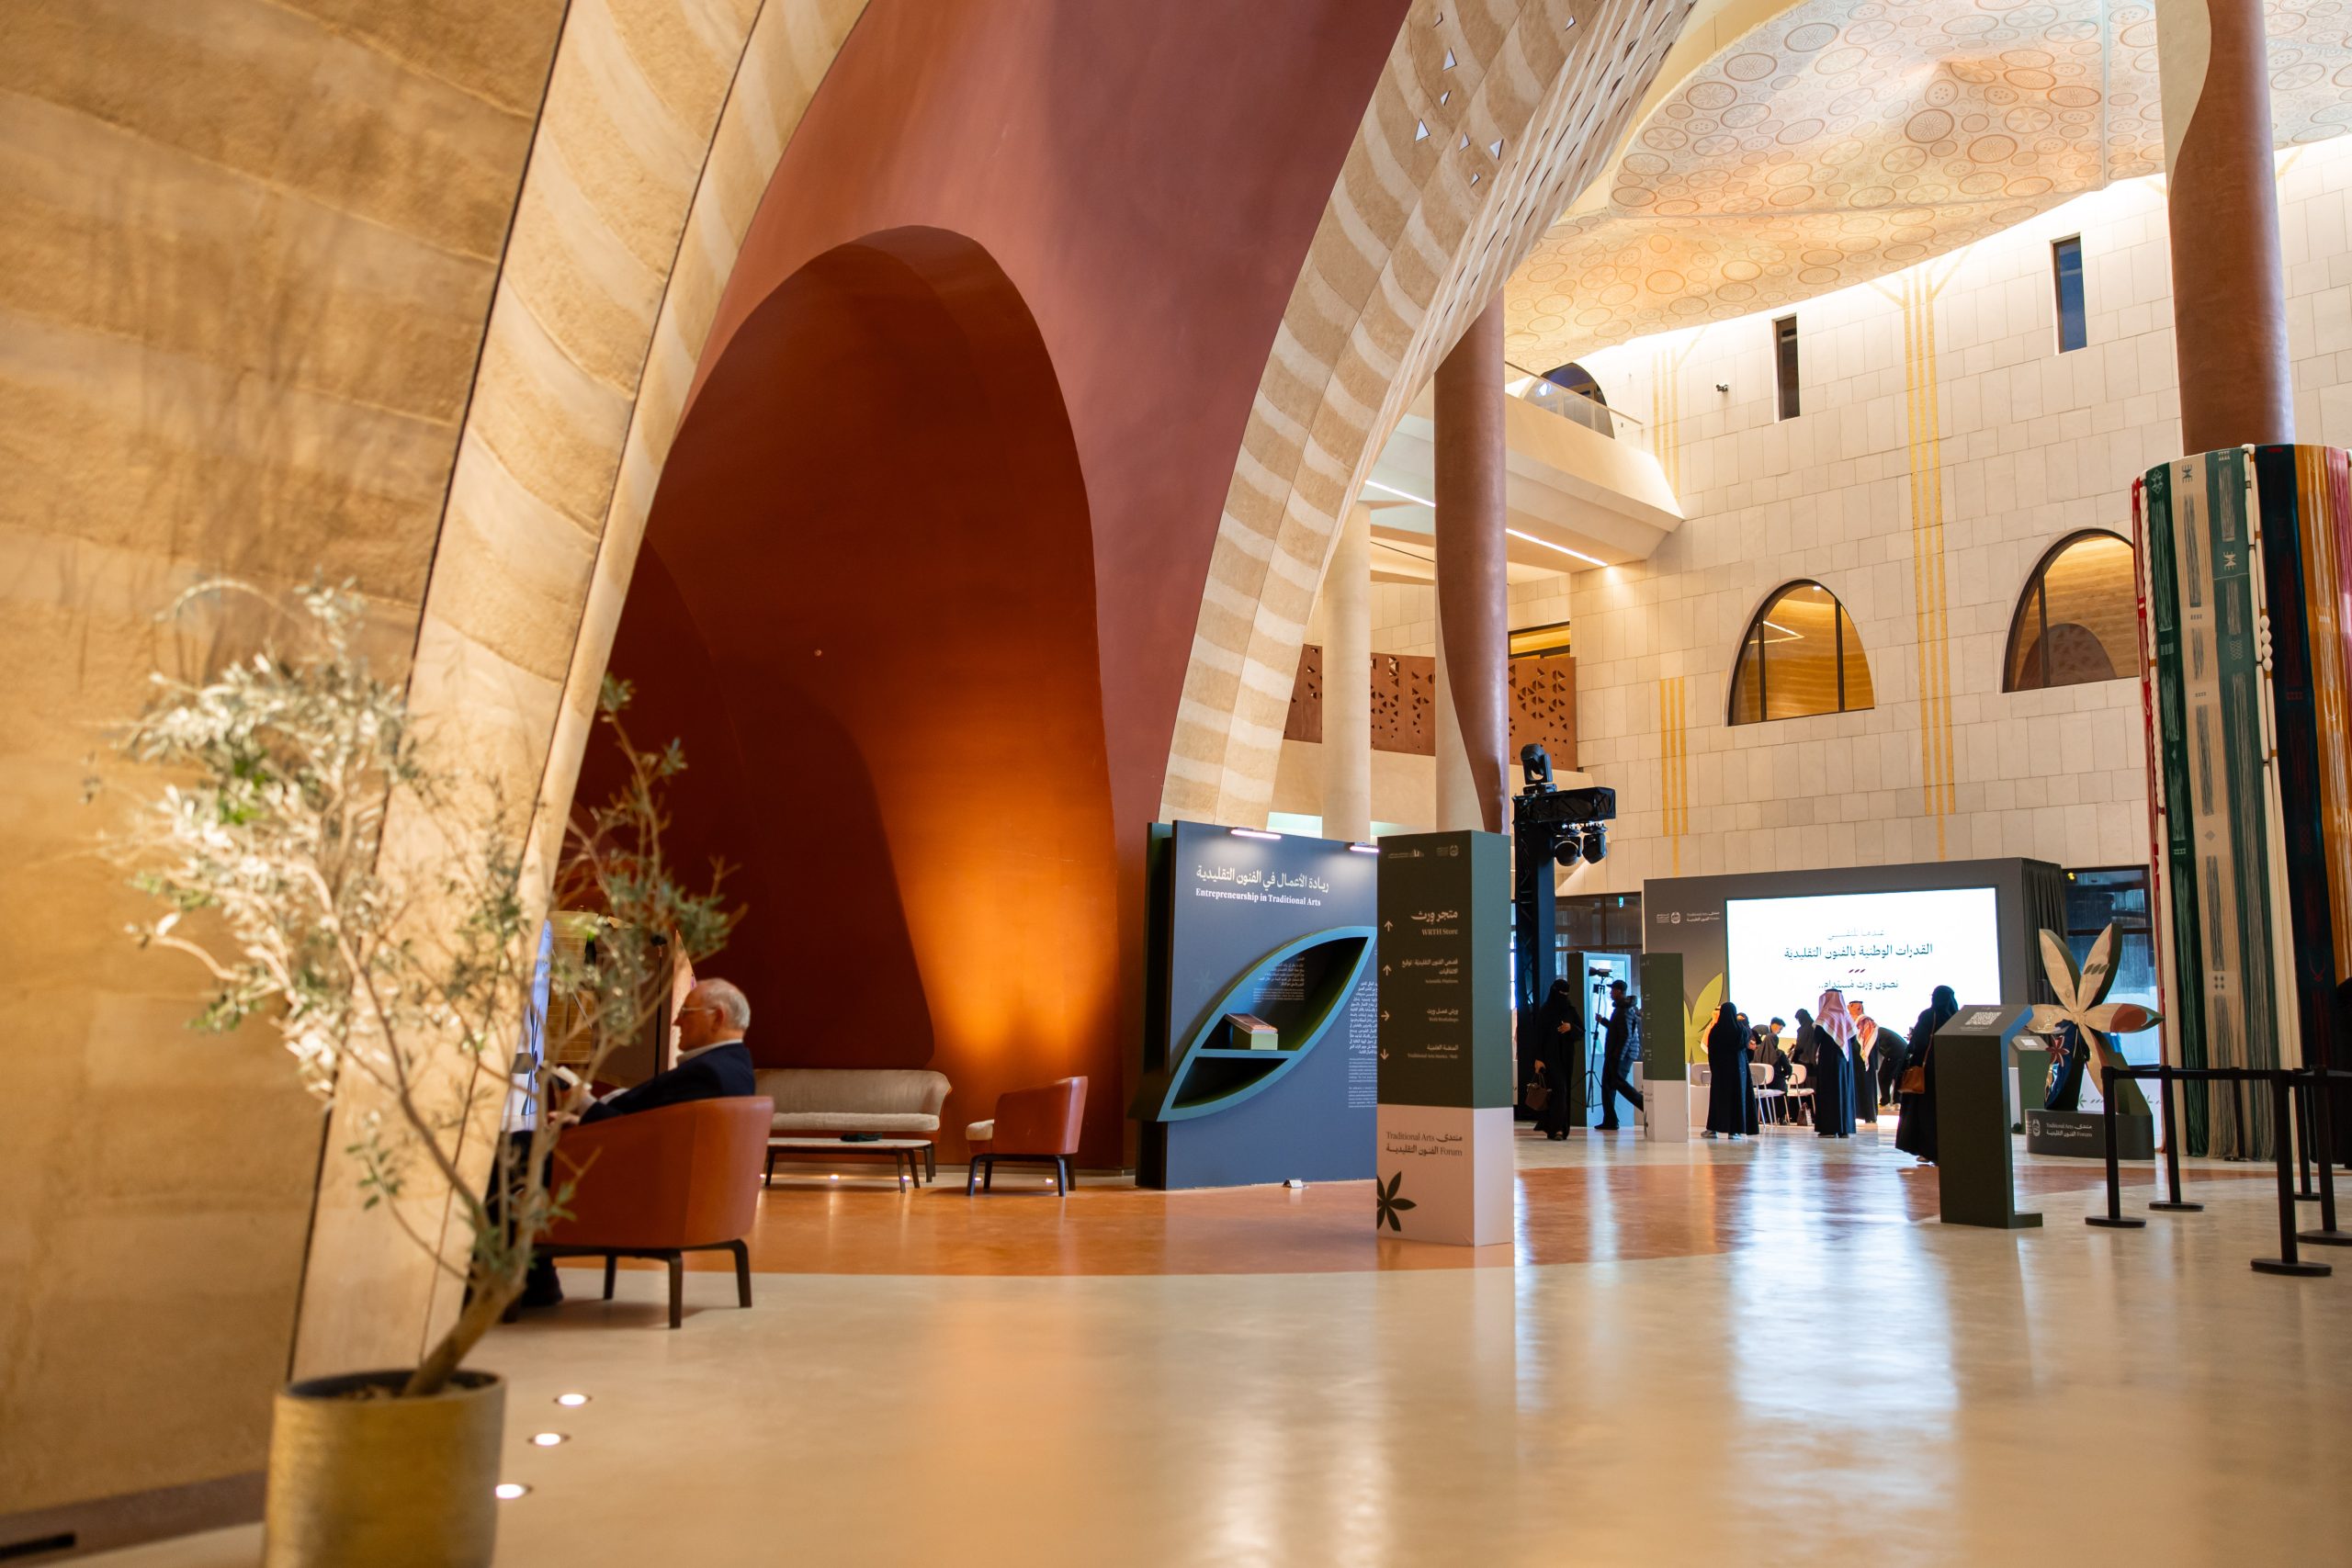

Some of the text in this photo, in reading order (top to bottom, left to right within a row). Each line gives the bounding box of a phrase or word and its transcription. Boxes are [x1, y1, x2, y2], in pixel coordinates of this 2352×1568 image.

[1196, 864, 1329, 893] ريادة الأعمال في الفنون التقليدية
[1195, 887, 1321, 907] Entrepreneurship in Traditional Arts
[1436, 910, 1458, 922] متجر
[1784, 943, 1933, 961] القدرات الوطنية بالفنون التقليدية
[1386, 1131, 1420, 1141] Traditional
[1436, 1134, 1463, 1143] منتدى
[1385, 1143, 1439, 1156] الفنون التقليدية
[1440, 1147, 1463, 1156] Forum
